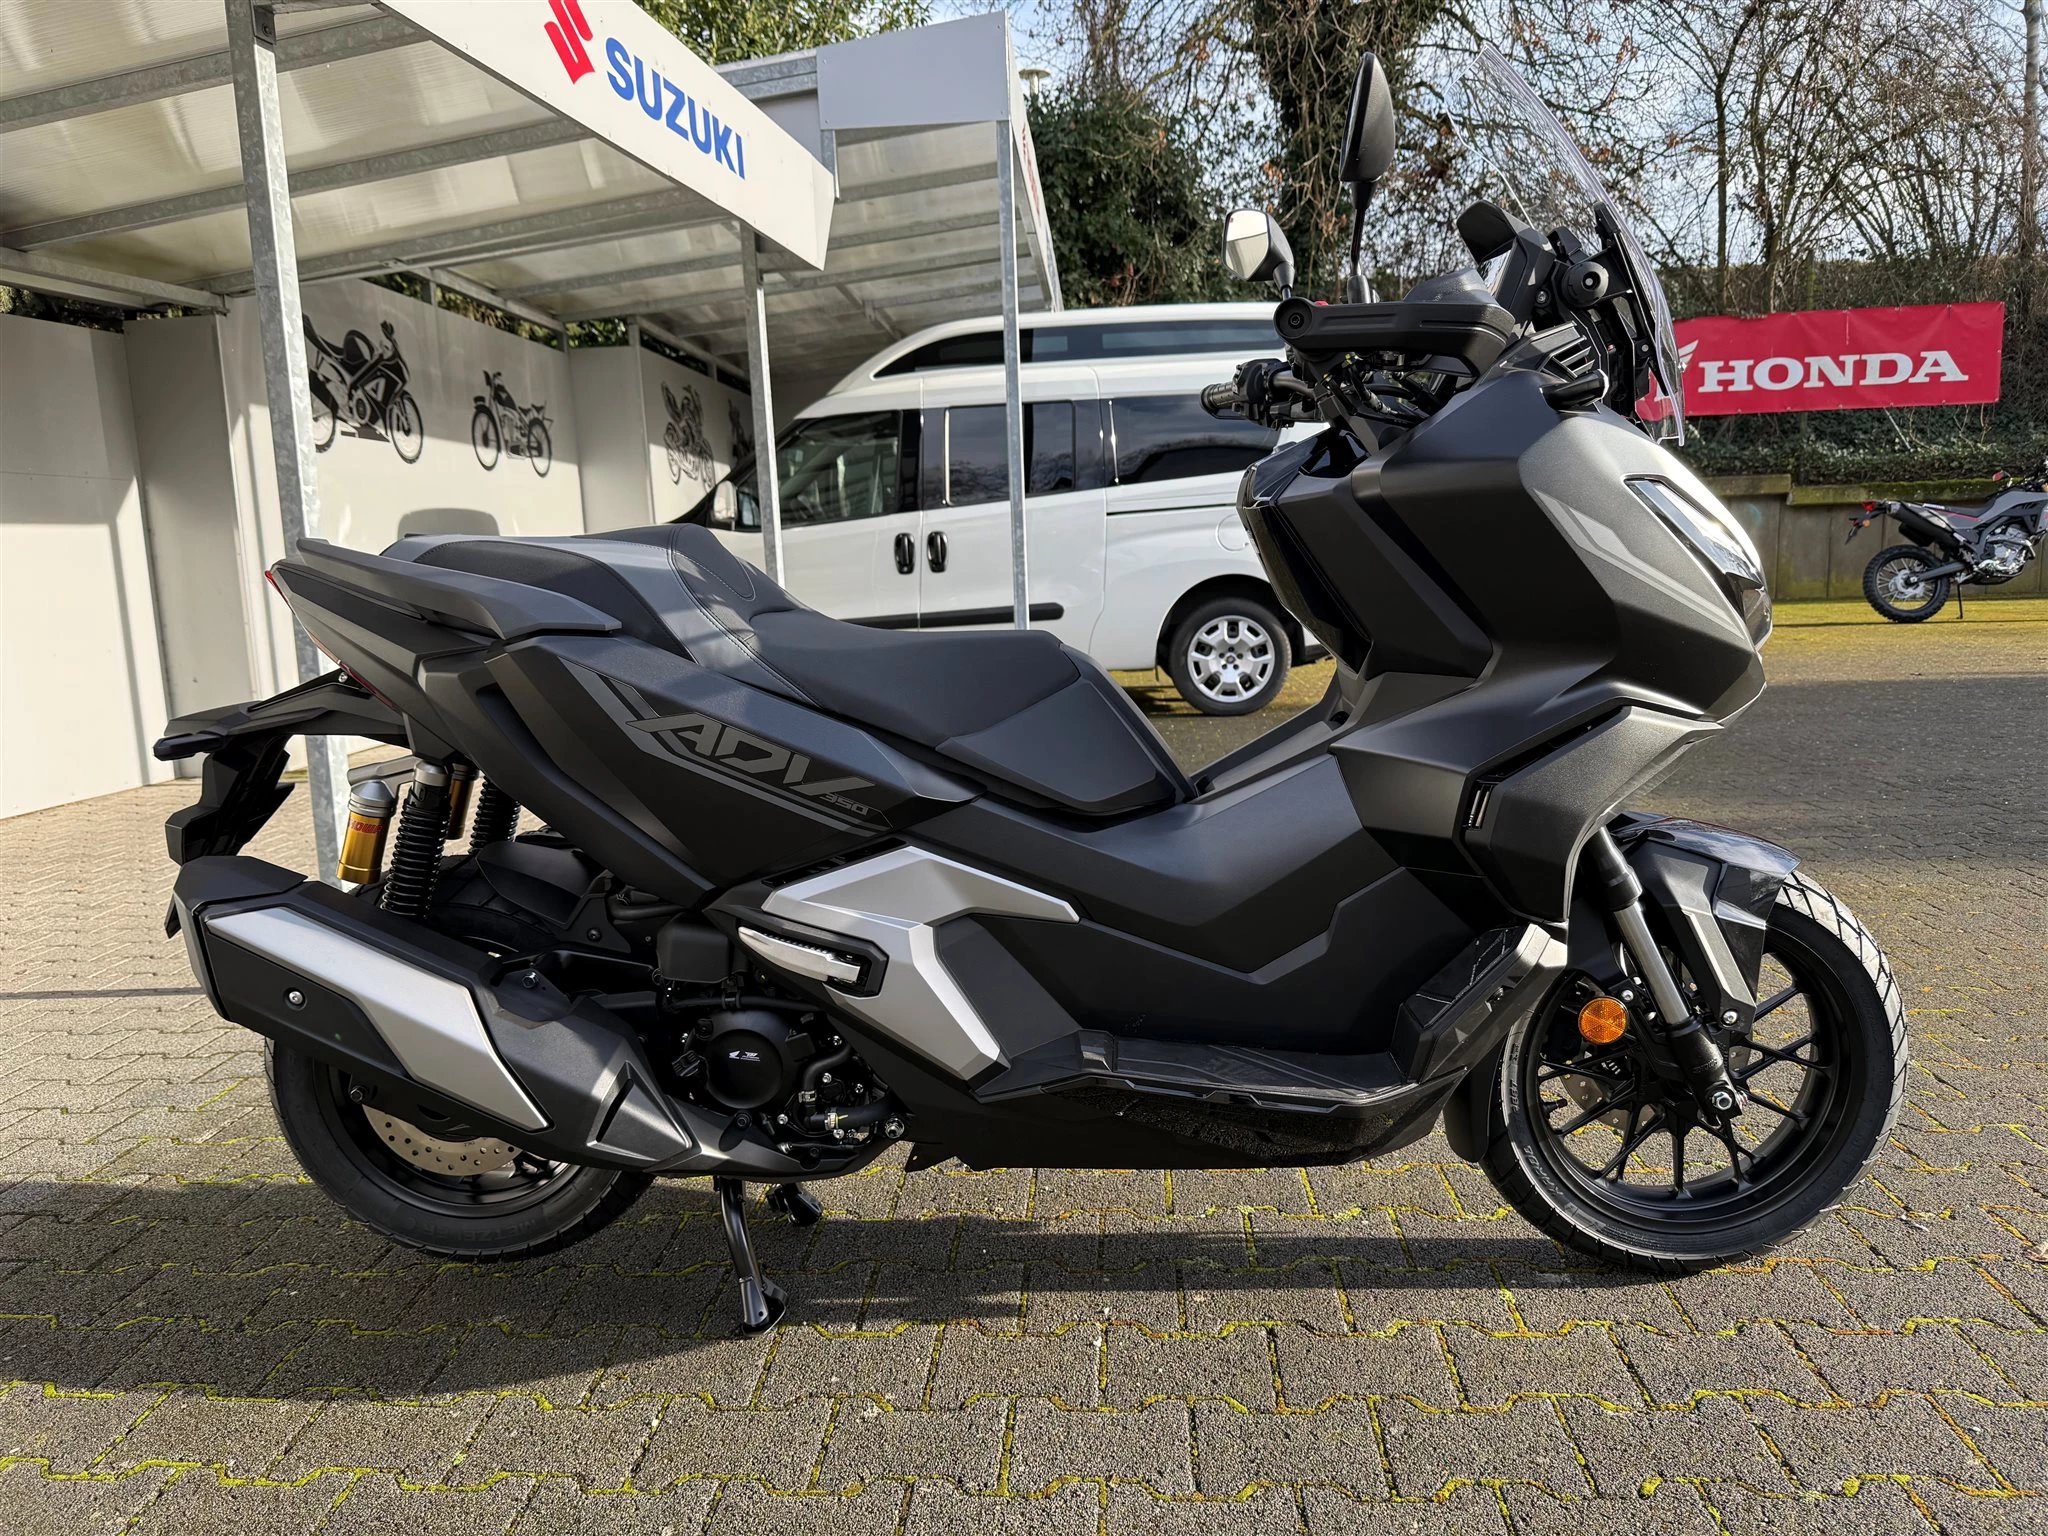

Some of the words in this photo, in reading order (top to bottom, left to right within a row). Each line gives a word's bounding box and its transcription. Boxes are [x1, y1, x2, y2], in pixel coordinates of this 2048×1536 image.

[605, 37, 746, 180] SUZUKI
[1698, 350, 1969, 393] HONDA
[625, 711, 876, 796] ADV
[820, 792, 869, 816] 350
